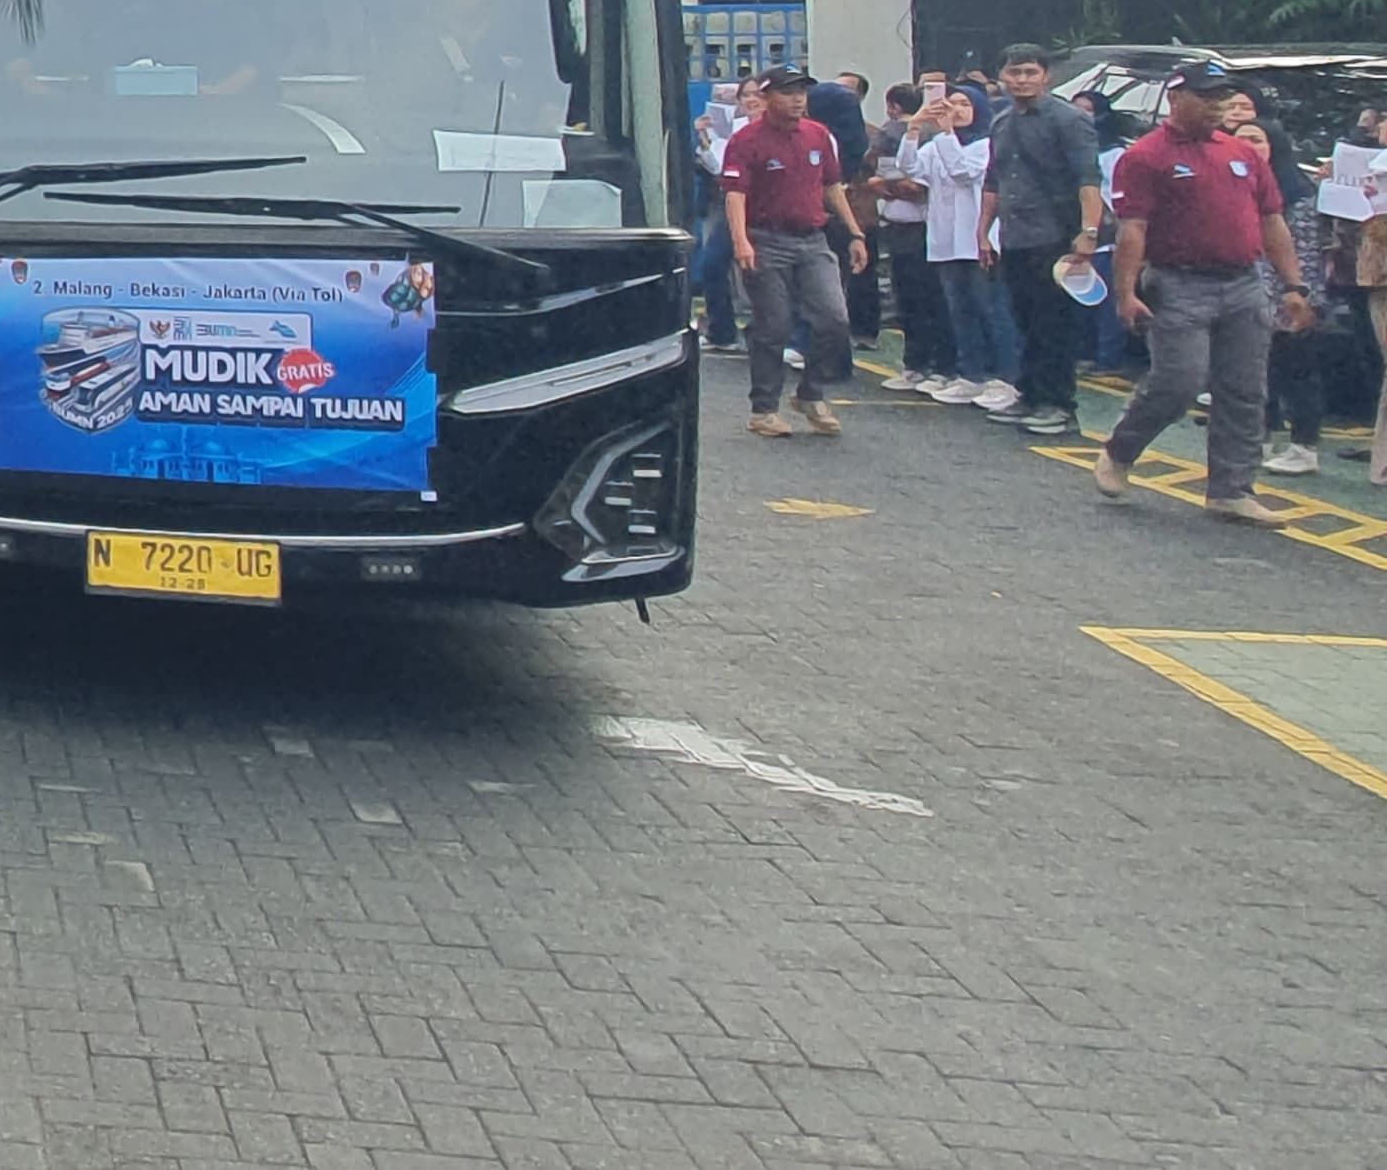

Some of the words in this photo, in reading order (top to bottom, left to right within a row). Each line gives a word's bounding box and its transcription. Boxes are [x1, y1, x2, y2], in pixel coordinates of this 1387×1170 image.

[53, 281, 112, 299] Malang
[130, 283, 185, 298] Bekasi
[203, 285, 266, 300] Jakarta
[272, 286, 306, 302] (Via
[312, 287, 343, 303] Tol)
[145, 348, 273, 384] MUDIK
[276, 361, 336, 381] GRATIS
[139, 391, 211, 414] AMAN
[217, 395, 304, 418] SAMPAI
[310, 397, 402, 422] TUJUAN
[93, 538, 111, 568] N
[140, 541, 212, 574] 7220
[236, 547, 272, 578] UG
